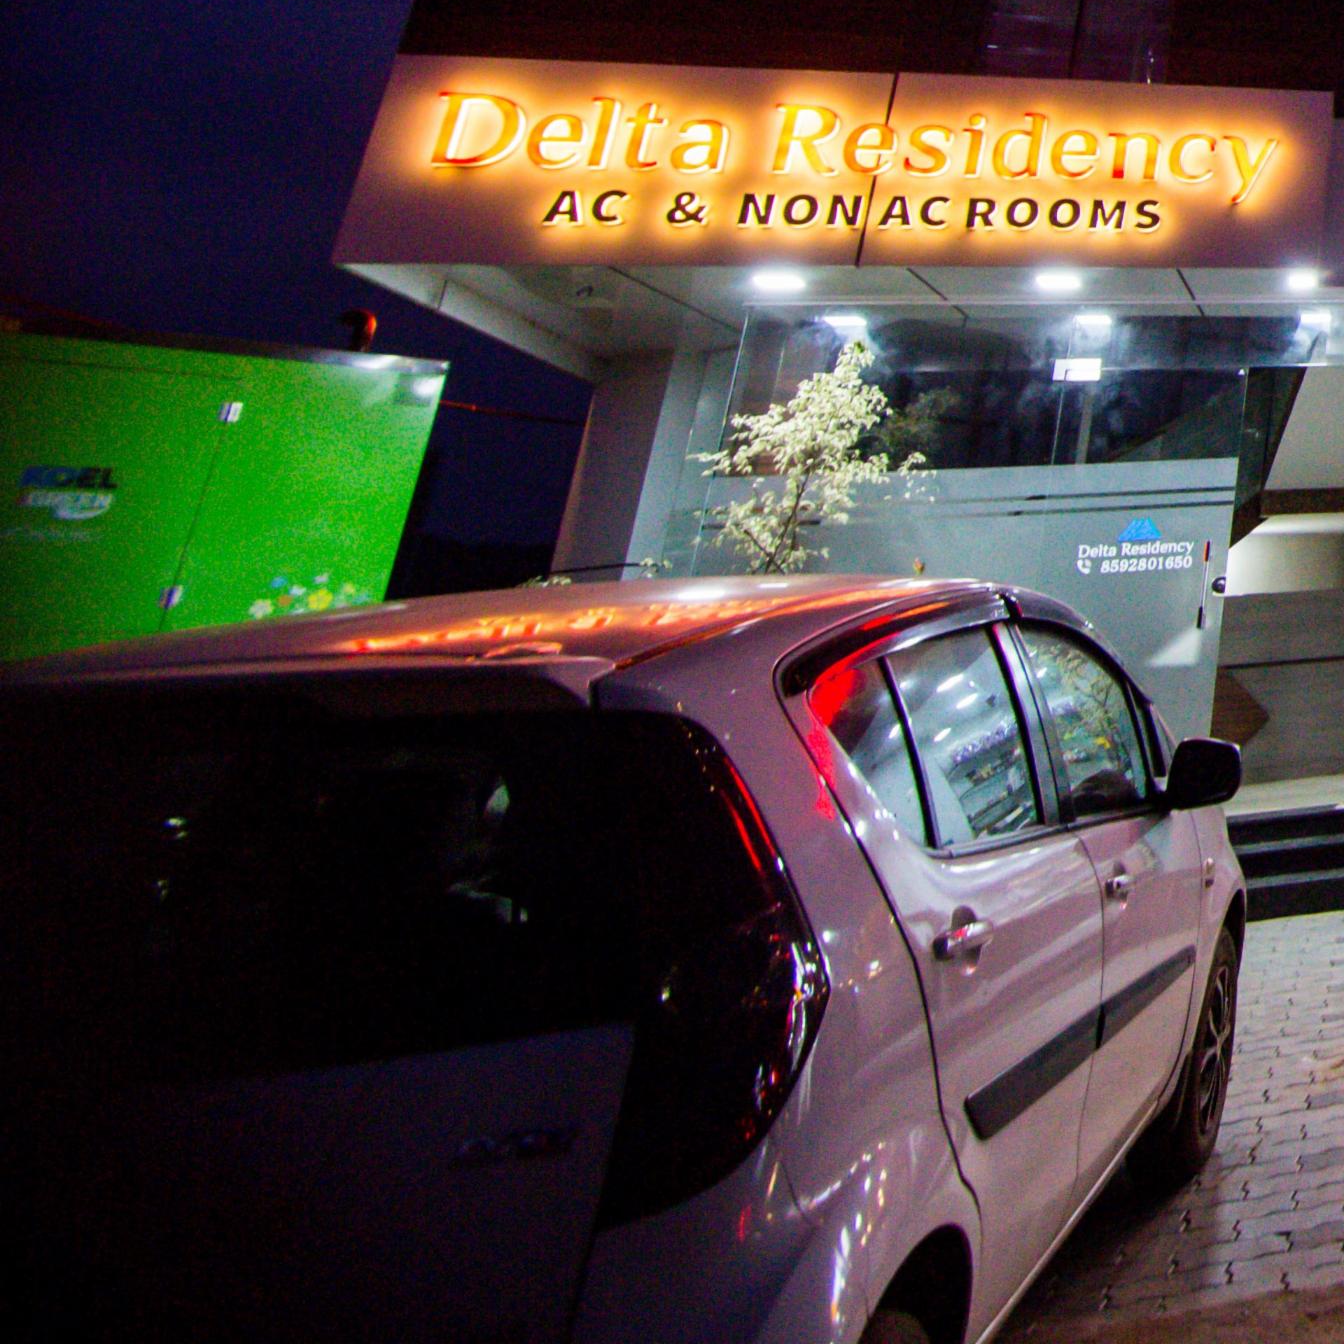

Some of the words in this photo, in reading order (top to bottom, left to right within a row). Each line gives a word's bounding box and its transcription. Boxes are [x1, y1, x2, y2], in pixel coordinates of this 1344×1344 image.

[429, 90, 731, 175] Delta
[772, 102, 1280, 206] Residency
[543, 189, 629, 229] AC
[667, 191, 706, 227] &
[738, 192, 863, 232] NON
[1078, 544, 1117, 559] Delta
[1121, 540, 1194, 557] Residency
[1100, 556, 1193, 574] 8592801650
